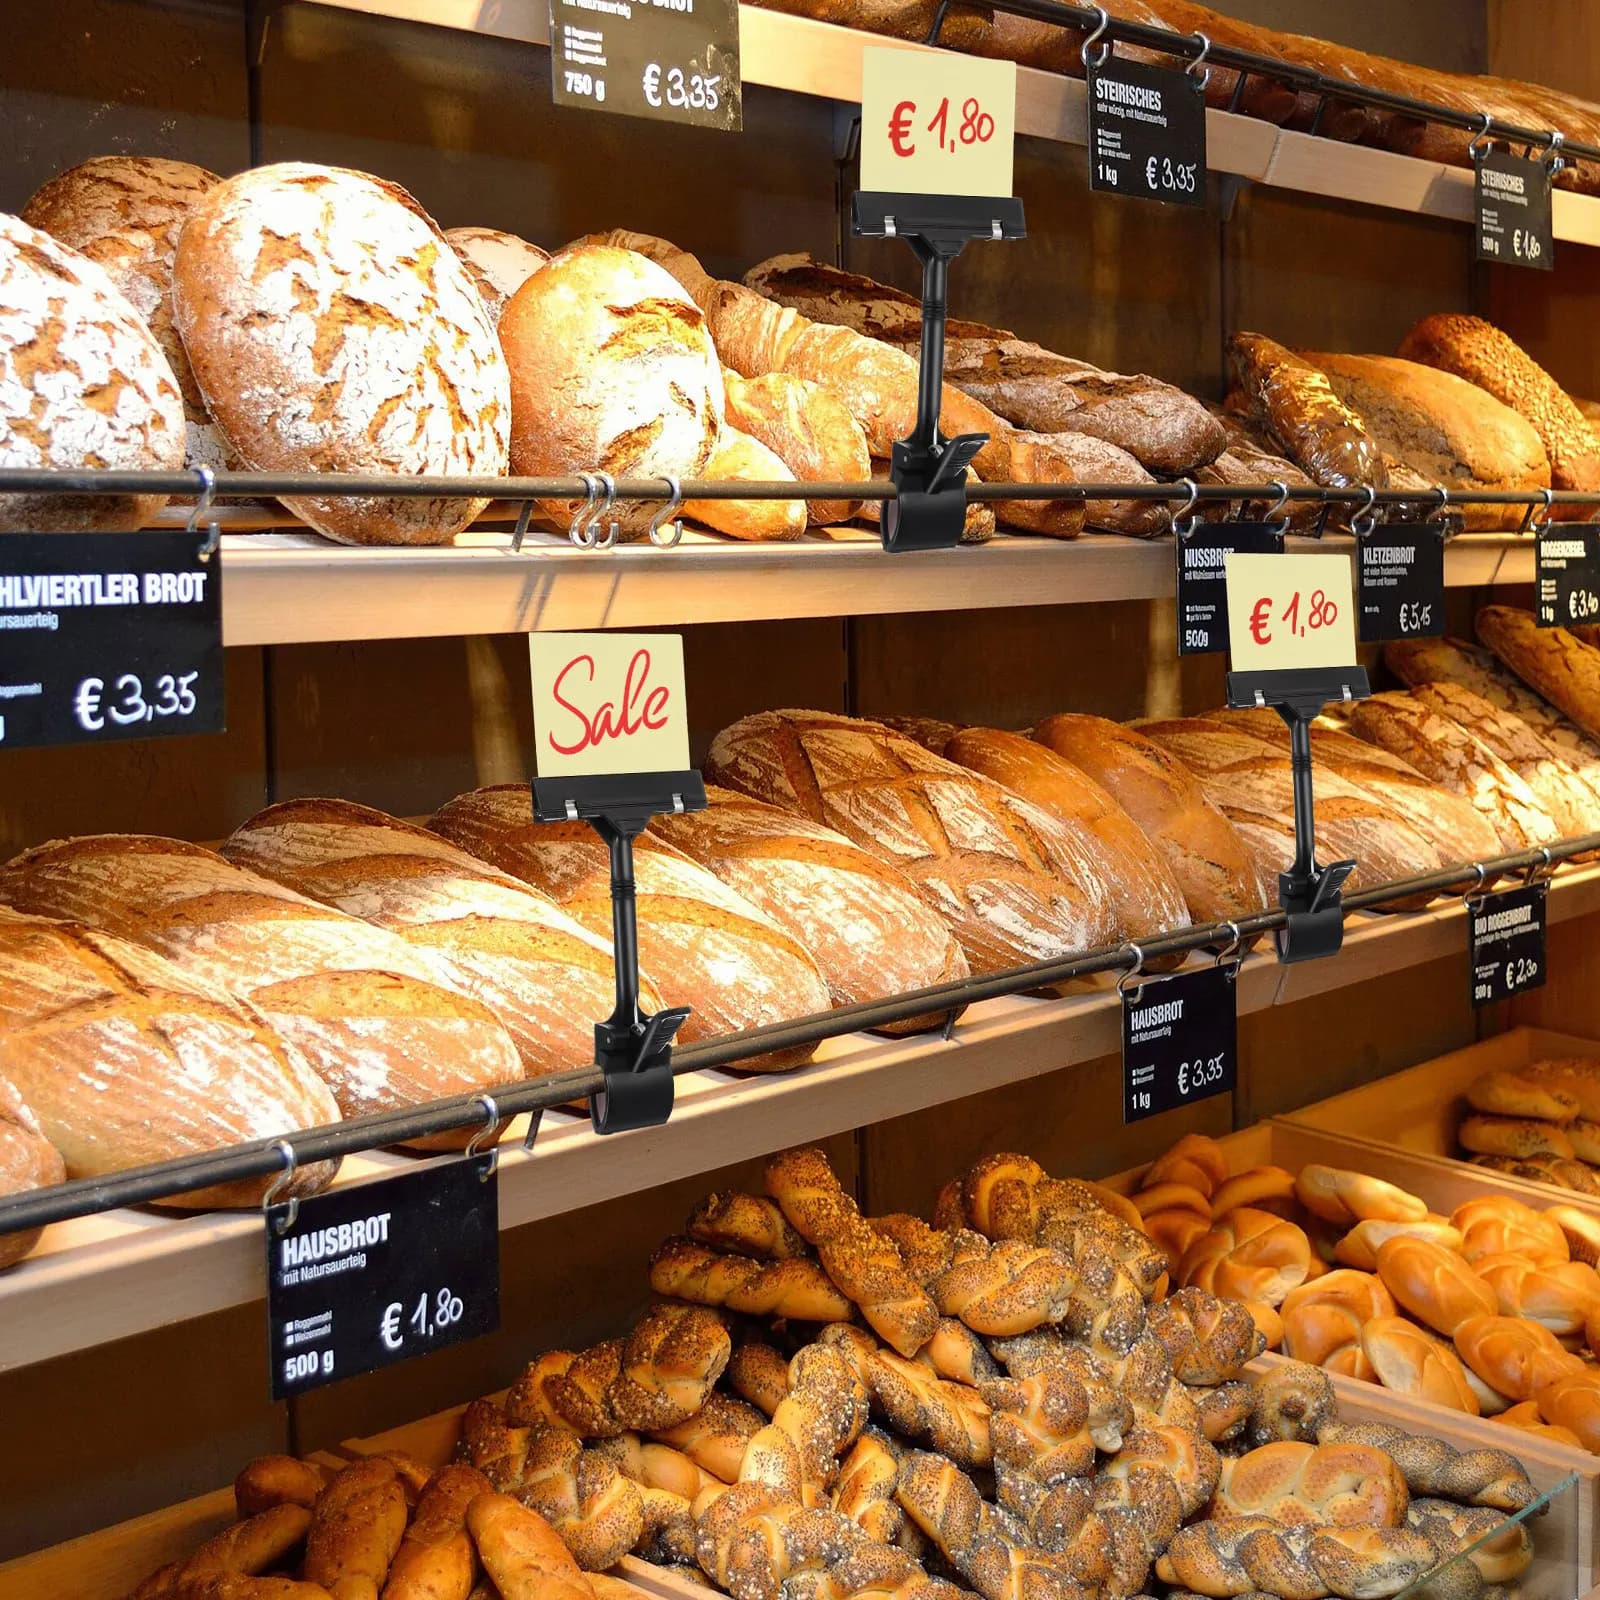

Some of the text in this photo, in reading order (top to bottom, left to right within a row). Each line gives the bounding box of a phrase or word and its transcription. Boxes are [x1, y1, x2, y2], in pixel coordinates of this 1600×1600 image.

[565, 71, 606, 102] 750 g
[1096, 78, 1162, 112] STEIRISCHES
[888, 97, 994, 157] € 1,80
[1098, 164, 1118, 185] 1 kg
[1162, 157, 1197, 193] 3,35
[1481, 168, 1525, 195] STEIRISCHES
[1184, 548, 1235, 568] NUSSBRO
[1363, 546, 1416, 565] KLETZENBROT
[145, 572, 207, 603] BROT
[1250, 589, 1338, 646] € 1,80
[1185, 629, 1209, 648] 500g
[549, 649, 669, 755] Sale
[1131, 999, 1184, 1032] HAUSBROT
[1192, 1052, 1224, 1087] 3,35
[1139, 1091, 1151, 1109] kg
[282, 1213, 391, 1268] HAUSBROT
[283, 1252, 367, 1286] mit Natursauerteig
[381, 1287, 464, 1349] € 1,80
[286, 1350, 334, 1380] 500 g
